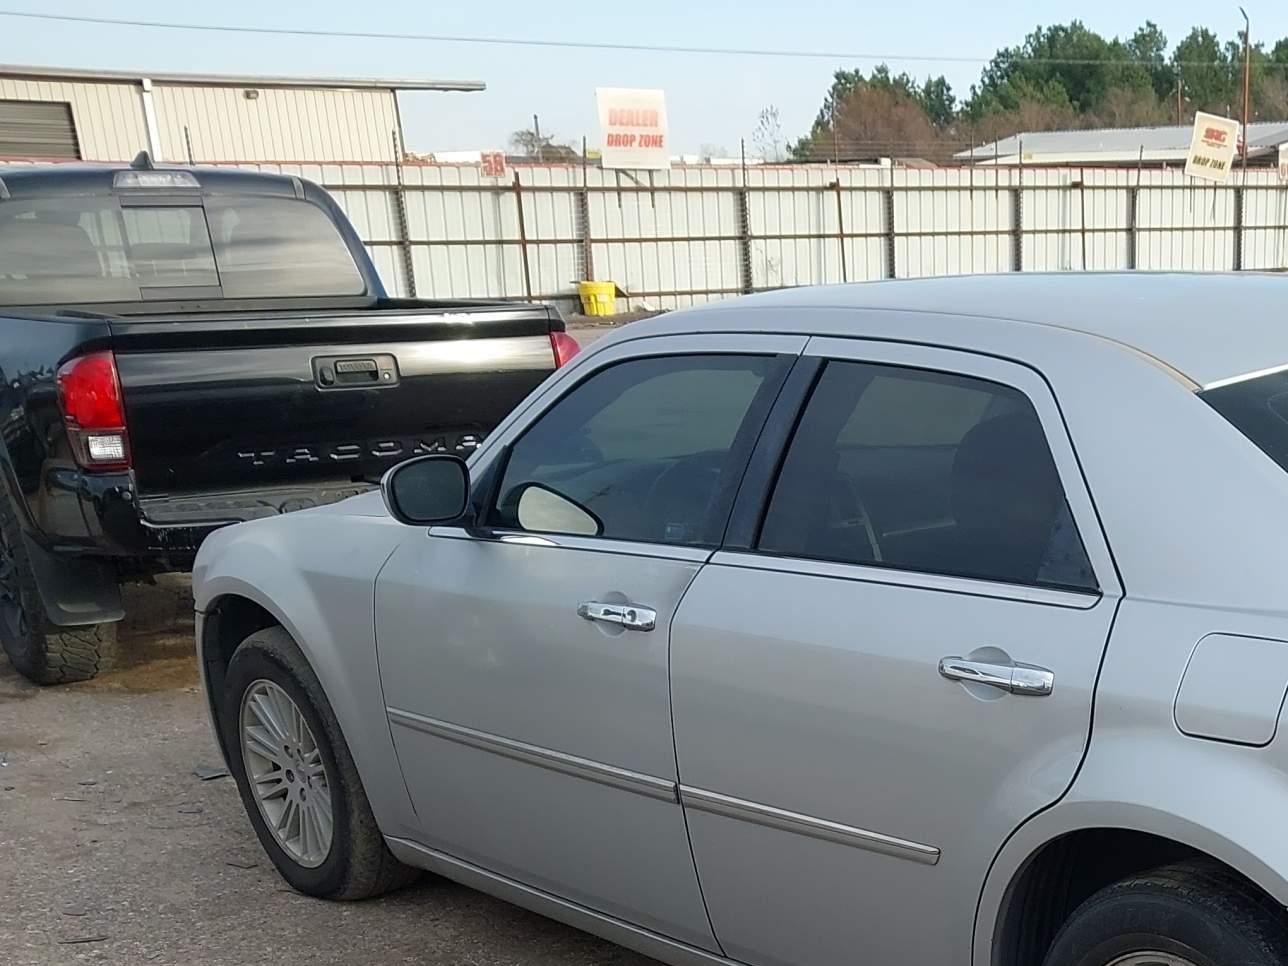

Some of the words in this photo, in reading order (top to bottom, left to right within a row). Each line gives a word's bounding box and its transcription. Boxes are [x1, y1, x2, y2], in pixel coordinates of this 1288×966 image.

[607, 133, 636, 147] DROP
[638, 134, 664, 148] ZONE
[1192, 155, 1210, 167] DROP
[1209, 159, 1226, 170] ZONE
[237, 434, 482, 465] TACOMA
